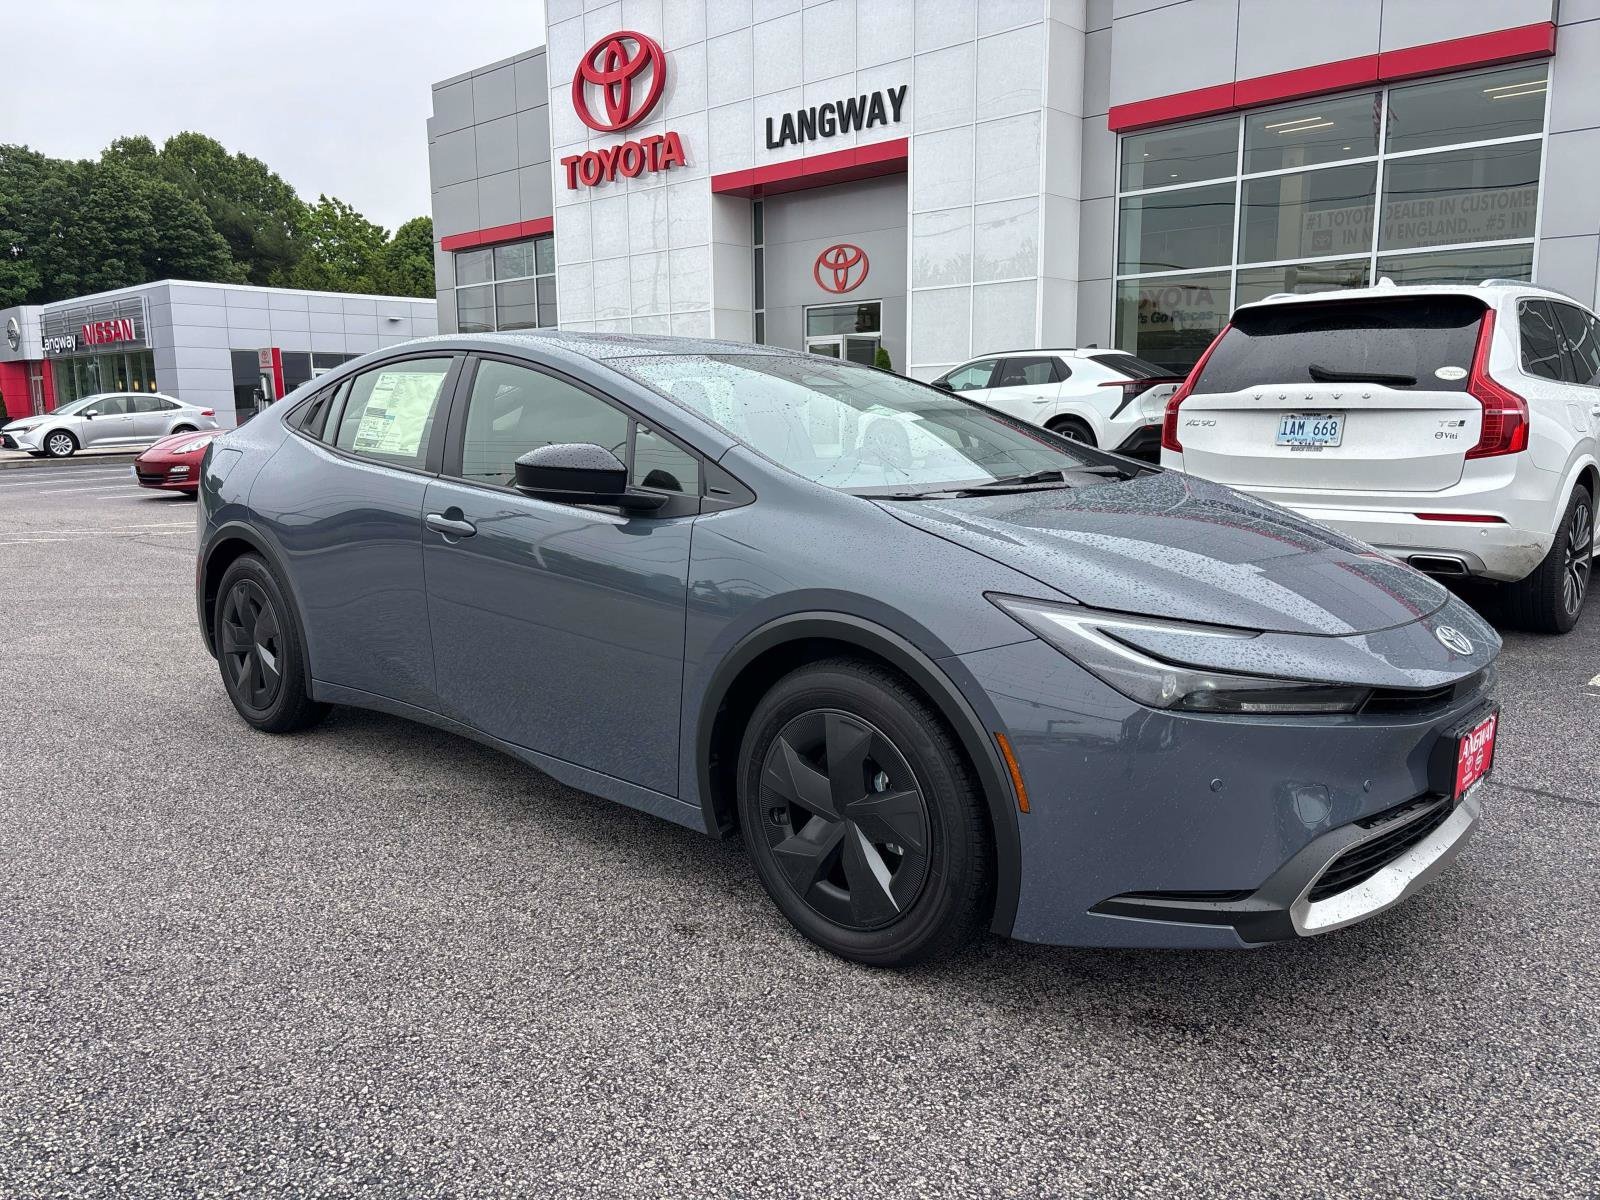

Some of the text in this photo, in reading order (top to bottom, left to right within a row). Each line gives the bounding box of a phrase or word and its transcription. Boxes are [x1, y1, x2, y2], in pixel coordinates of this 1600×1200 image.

[766, 85, 907, 149] LANGWAY
[561, 131, 687, 190] TOYOTA
[1306, 213, 1322, 229] #1
[1386, 201, 1434, 220] DEALER
[1440, 198, 1456, 215] IN
[1342, 228, 1357, 246] IN
[1362, 226, 1395, 243] NW
[1397, 217, 1481, 240] ENGLAND...
[1486, 213, 1506, 231] #5
[1511, 211, 1528, 229] IN
[1138, 286, 1215, 308] OYOTA
[1150, 311, 1169, 323] Go
[41, 334, 77, 353] Langway
[82, 318, 135, 345] NISSAN
[1281, 421, 1338, 436] 1AM 668
[1444, 431, 1458, 439] Viti
